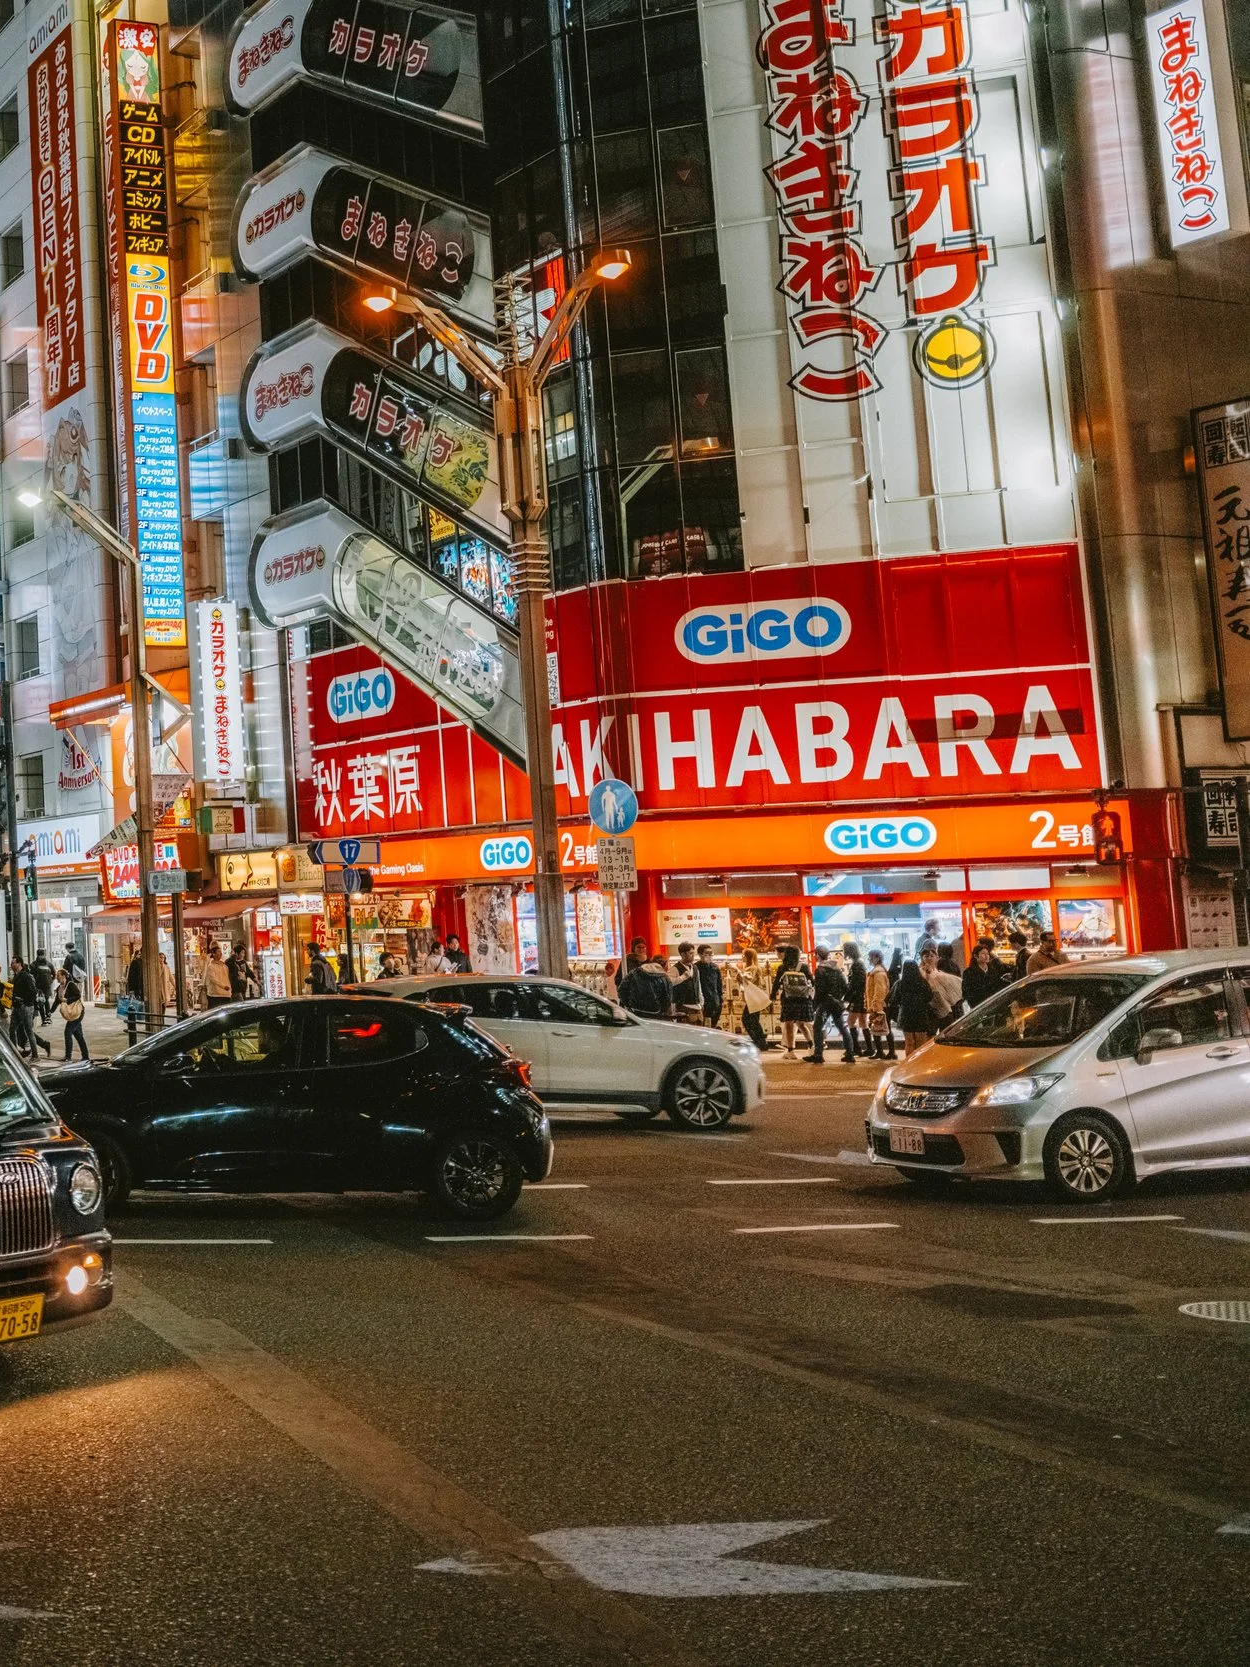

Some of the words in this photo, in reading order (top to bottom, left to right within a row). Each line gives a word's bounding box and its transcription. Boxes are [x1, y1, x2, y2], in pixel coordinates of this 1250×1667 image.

[29, 1, 68, 54] amiami
[118, 26, 155, 49] 激安
[237, 15, 295, 88] まねきねこ
[329, 18, 429, 78] カラオケ
[123, 104, 158, 122] ゲーム
[1158, 13, 1216, 231] まねきねこ
[127, 126, 156, 143] CD
[123, 147, 161, 166] アイドル
[874, 4, 996, 318] カラオケ
[124, 168, 162, 187] アニメ
[125, 191, 162, 209] コミック
[253, 196, 296, 236] カラオケ
[129, 212, 162, 230] ホビー
[341, 196, 464, 283] まねきねこ
[127, 235, 164, 254] フィギュア
[134, 292, 169, 383] DVD
[254, 363, 315, 422] まねきねこ
[349, 382, 455, 469] カラオケ
[271, 547, 318, 586] カラオケ
[211, 621, 228, 679] カラオケ
[331, 672, 392, 720] GiGO
[214, 694, 232, 775] まねきねこ
[313, 745, 423, 827] 秋葉原
[344, 843, 357, 859] 17
[482, 839, 531, 869] GiGO
[830, 821, 933, 851] GiGO
[297, 869, 324, 881] Lunch
[380, 864, 406, 876] Gaming
[406, 862, 425, 873] Oasis
